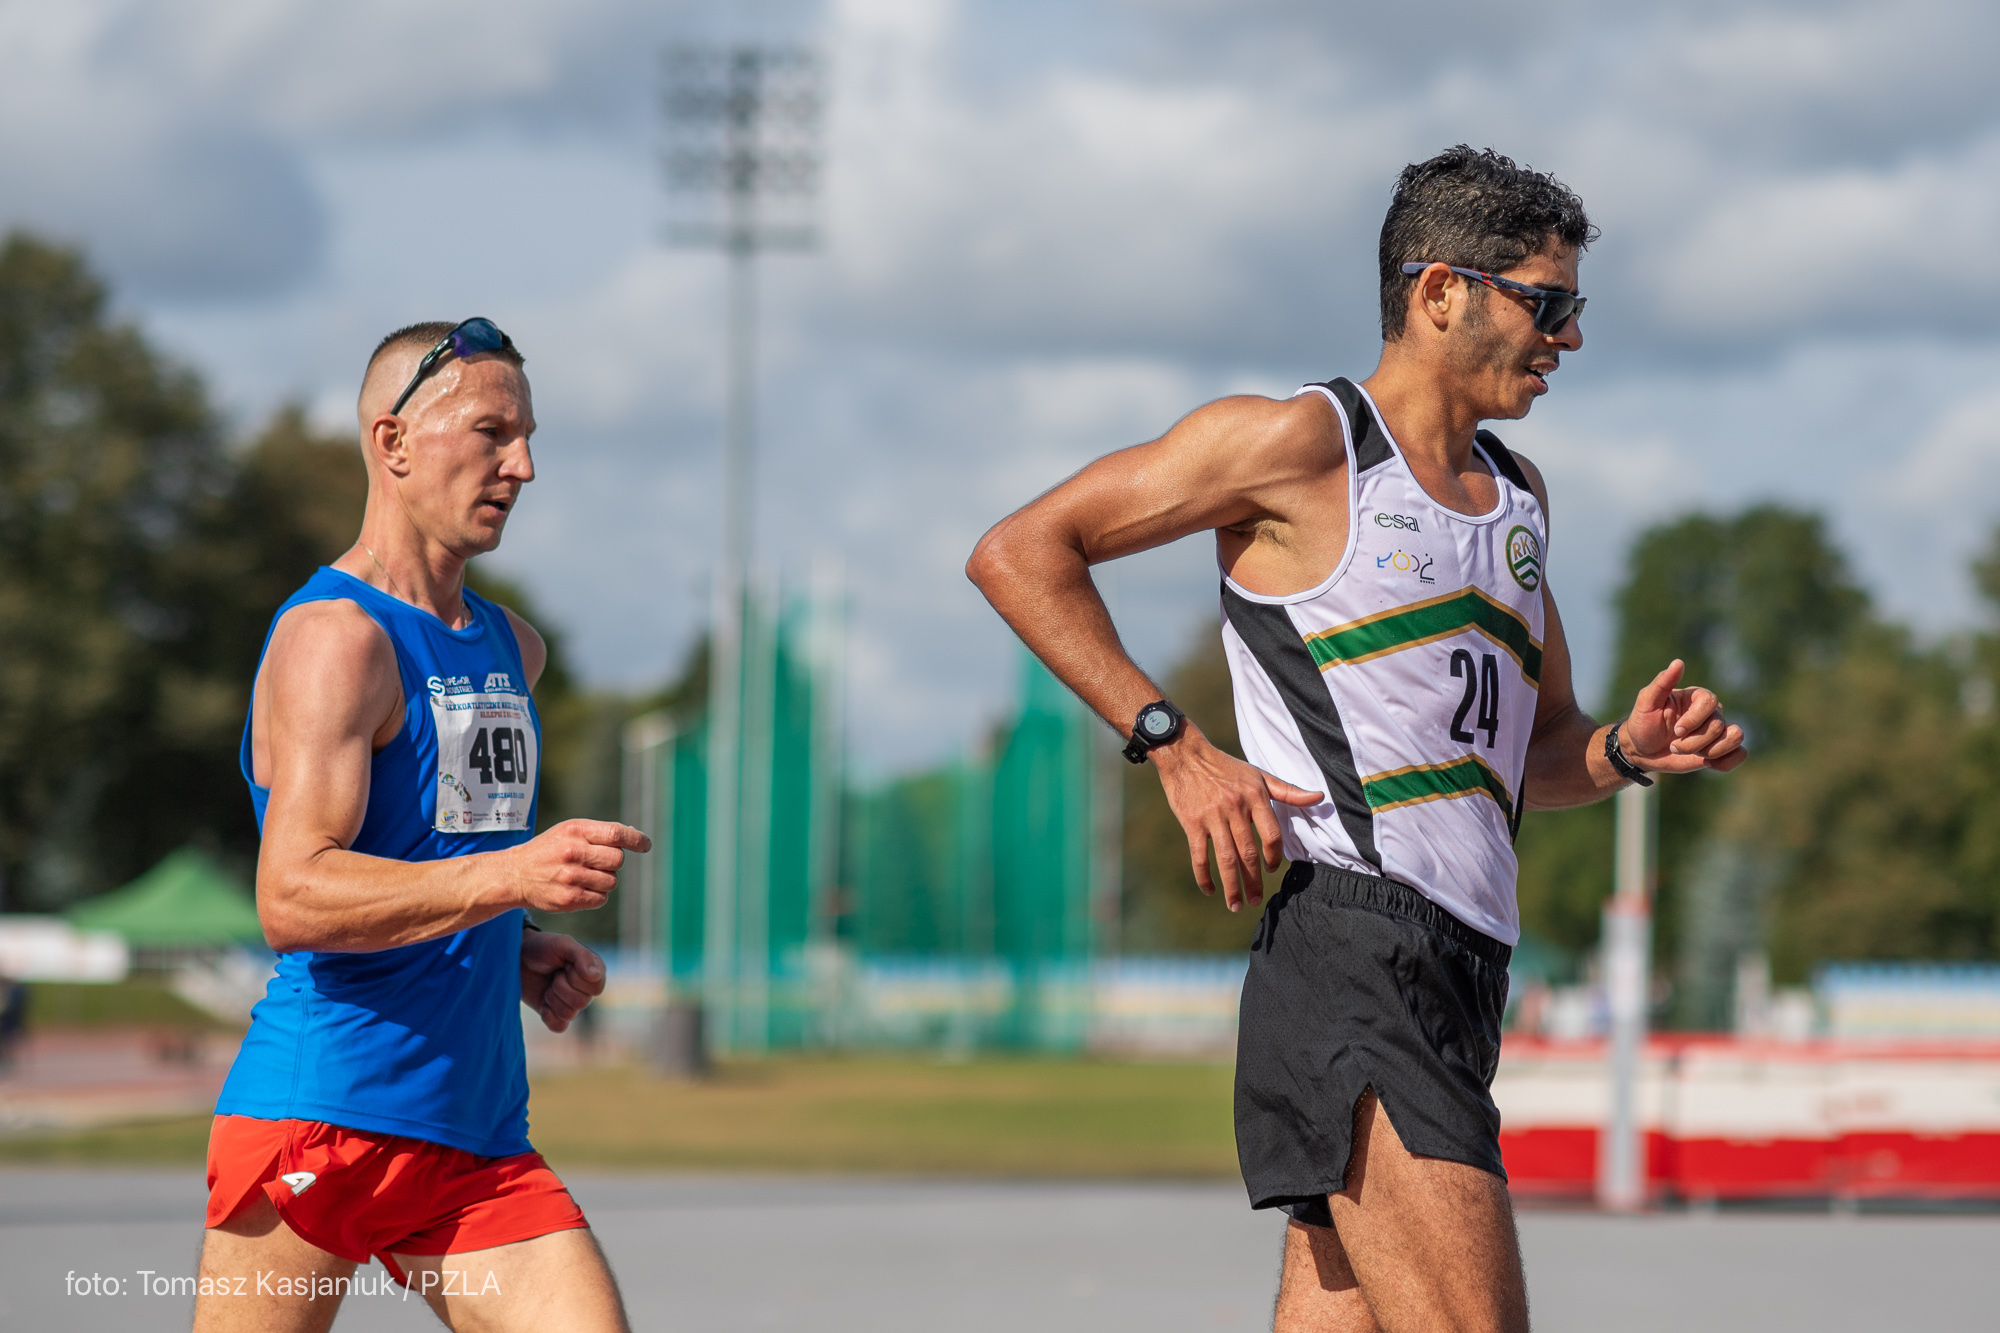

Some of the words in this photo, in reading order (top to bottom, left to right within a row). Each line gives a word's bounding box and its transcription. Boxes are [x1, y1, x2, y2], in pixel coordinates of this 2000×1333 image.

[1512, 535, 1538, 561] RKS
[484, 673, 510, 688] ATS
[1450, 648, 1499, 749] 24
[469, 727, 528, 784] 480
